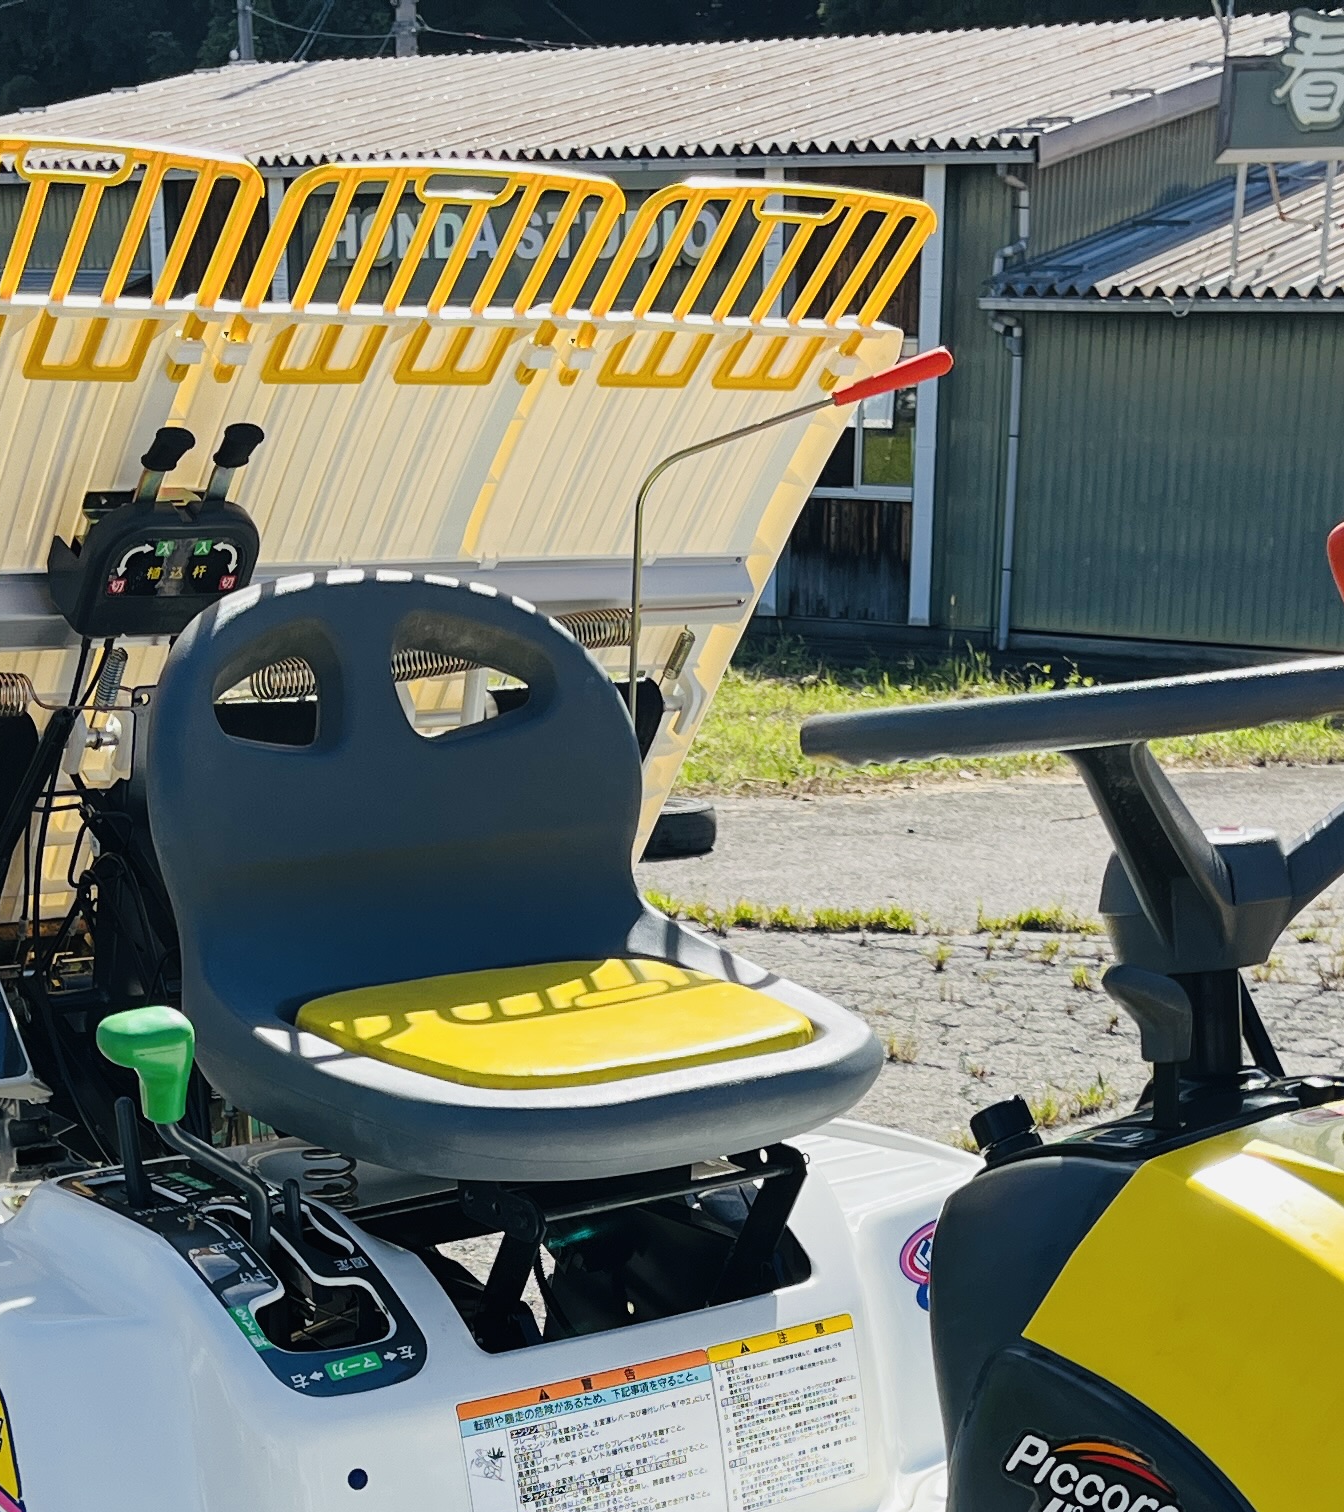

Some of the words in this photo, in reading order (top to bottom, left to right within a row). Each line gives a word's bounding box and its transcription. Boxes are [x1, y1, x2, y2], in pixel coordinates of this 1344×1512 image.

[330, 211, 498, 261] HONDA
[396, 1345, 416, 1360] 左
[331, 1356, 378, 1378] マーカ
[290, 1374, 310, 1389] 右
